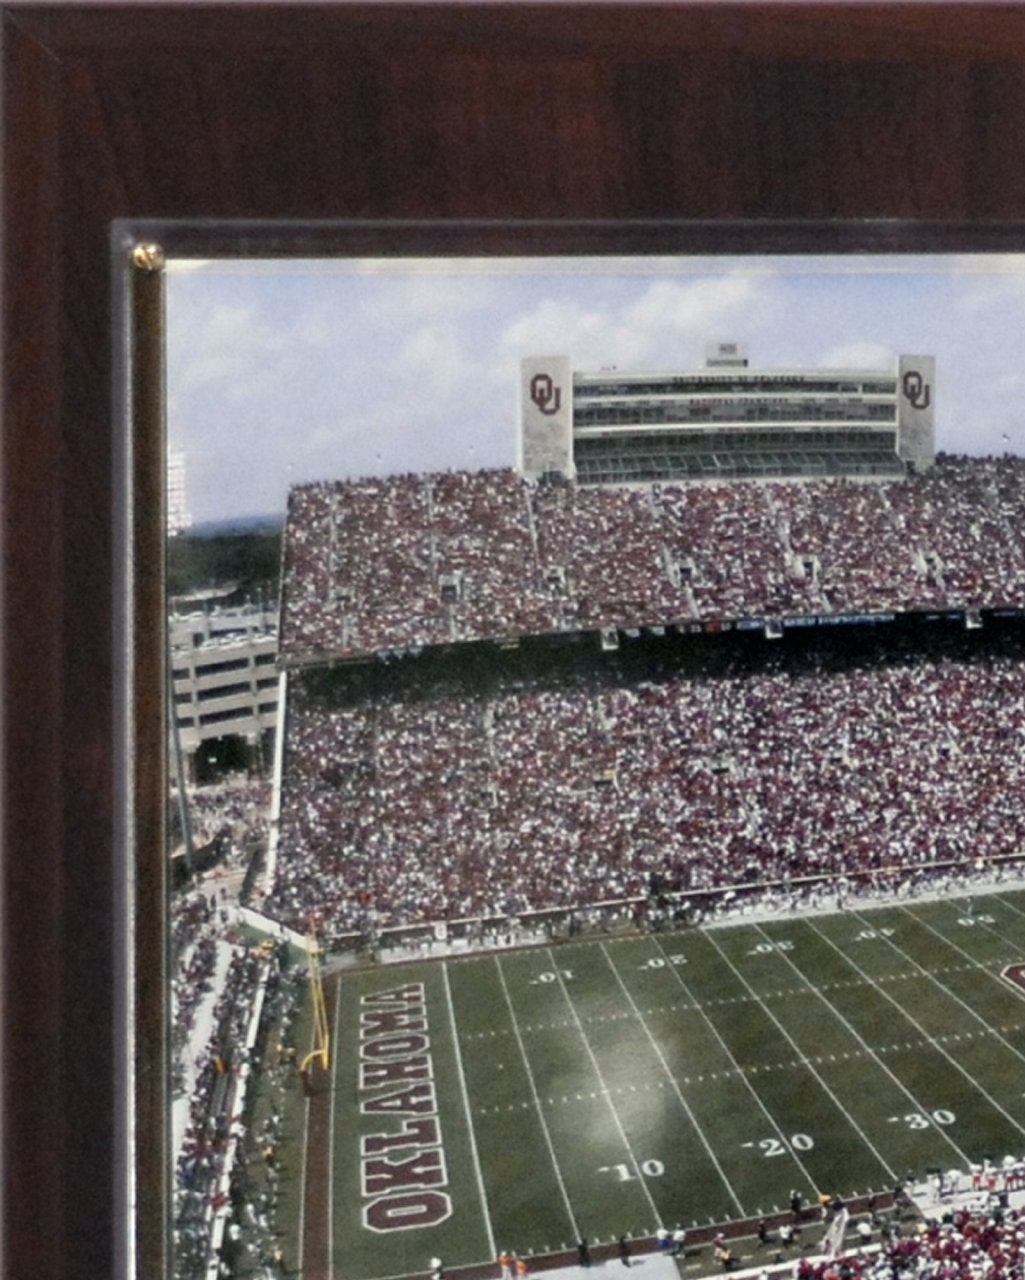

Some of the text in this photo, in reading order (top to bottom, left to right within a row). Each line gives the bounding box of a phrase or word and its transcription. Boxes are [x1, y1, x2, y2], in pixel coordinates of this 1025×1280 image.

[529, 372, 561, 415] OU
[903, 371, 930, 409] OU
[360, 982, 452, 1234] OKLAHOMA
[905, 1108, 957, 1130] 30
[759, 1133, 815, 1158] 20
[613, 1158, 665, 1182] 10
